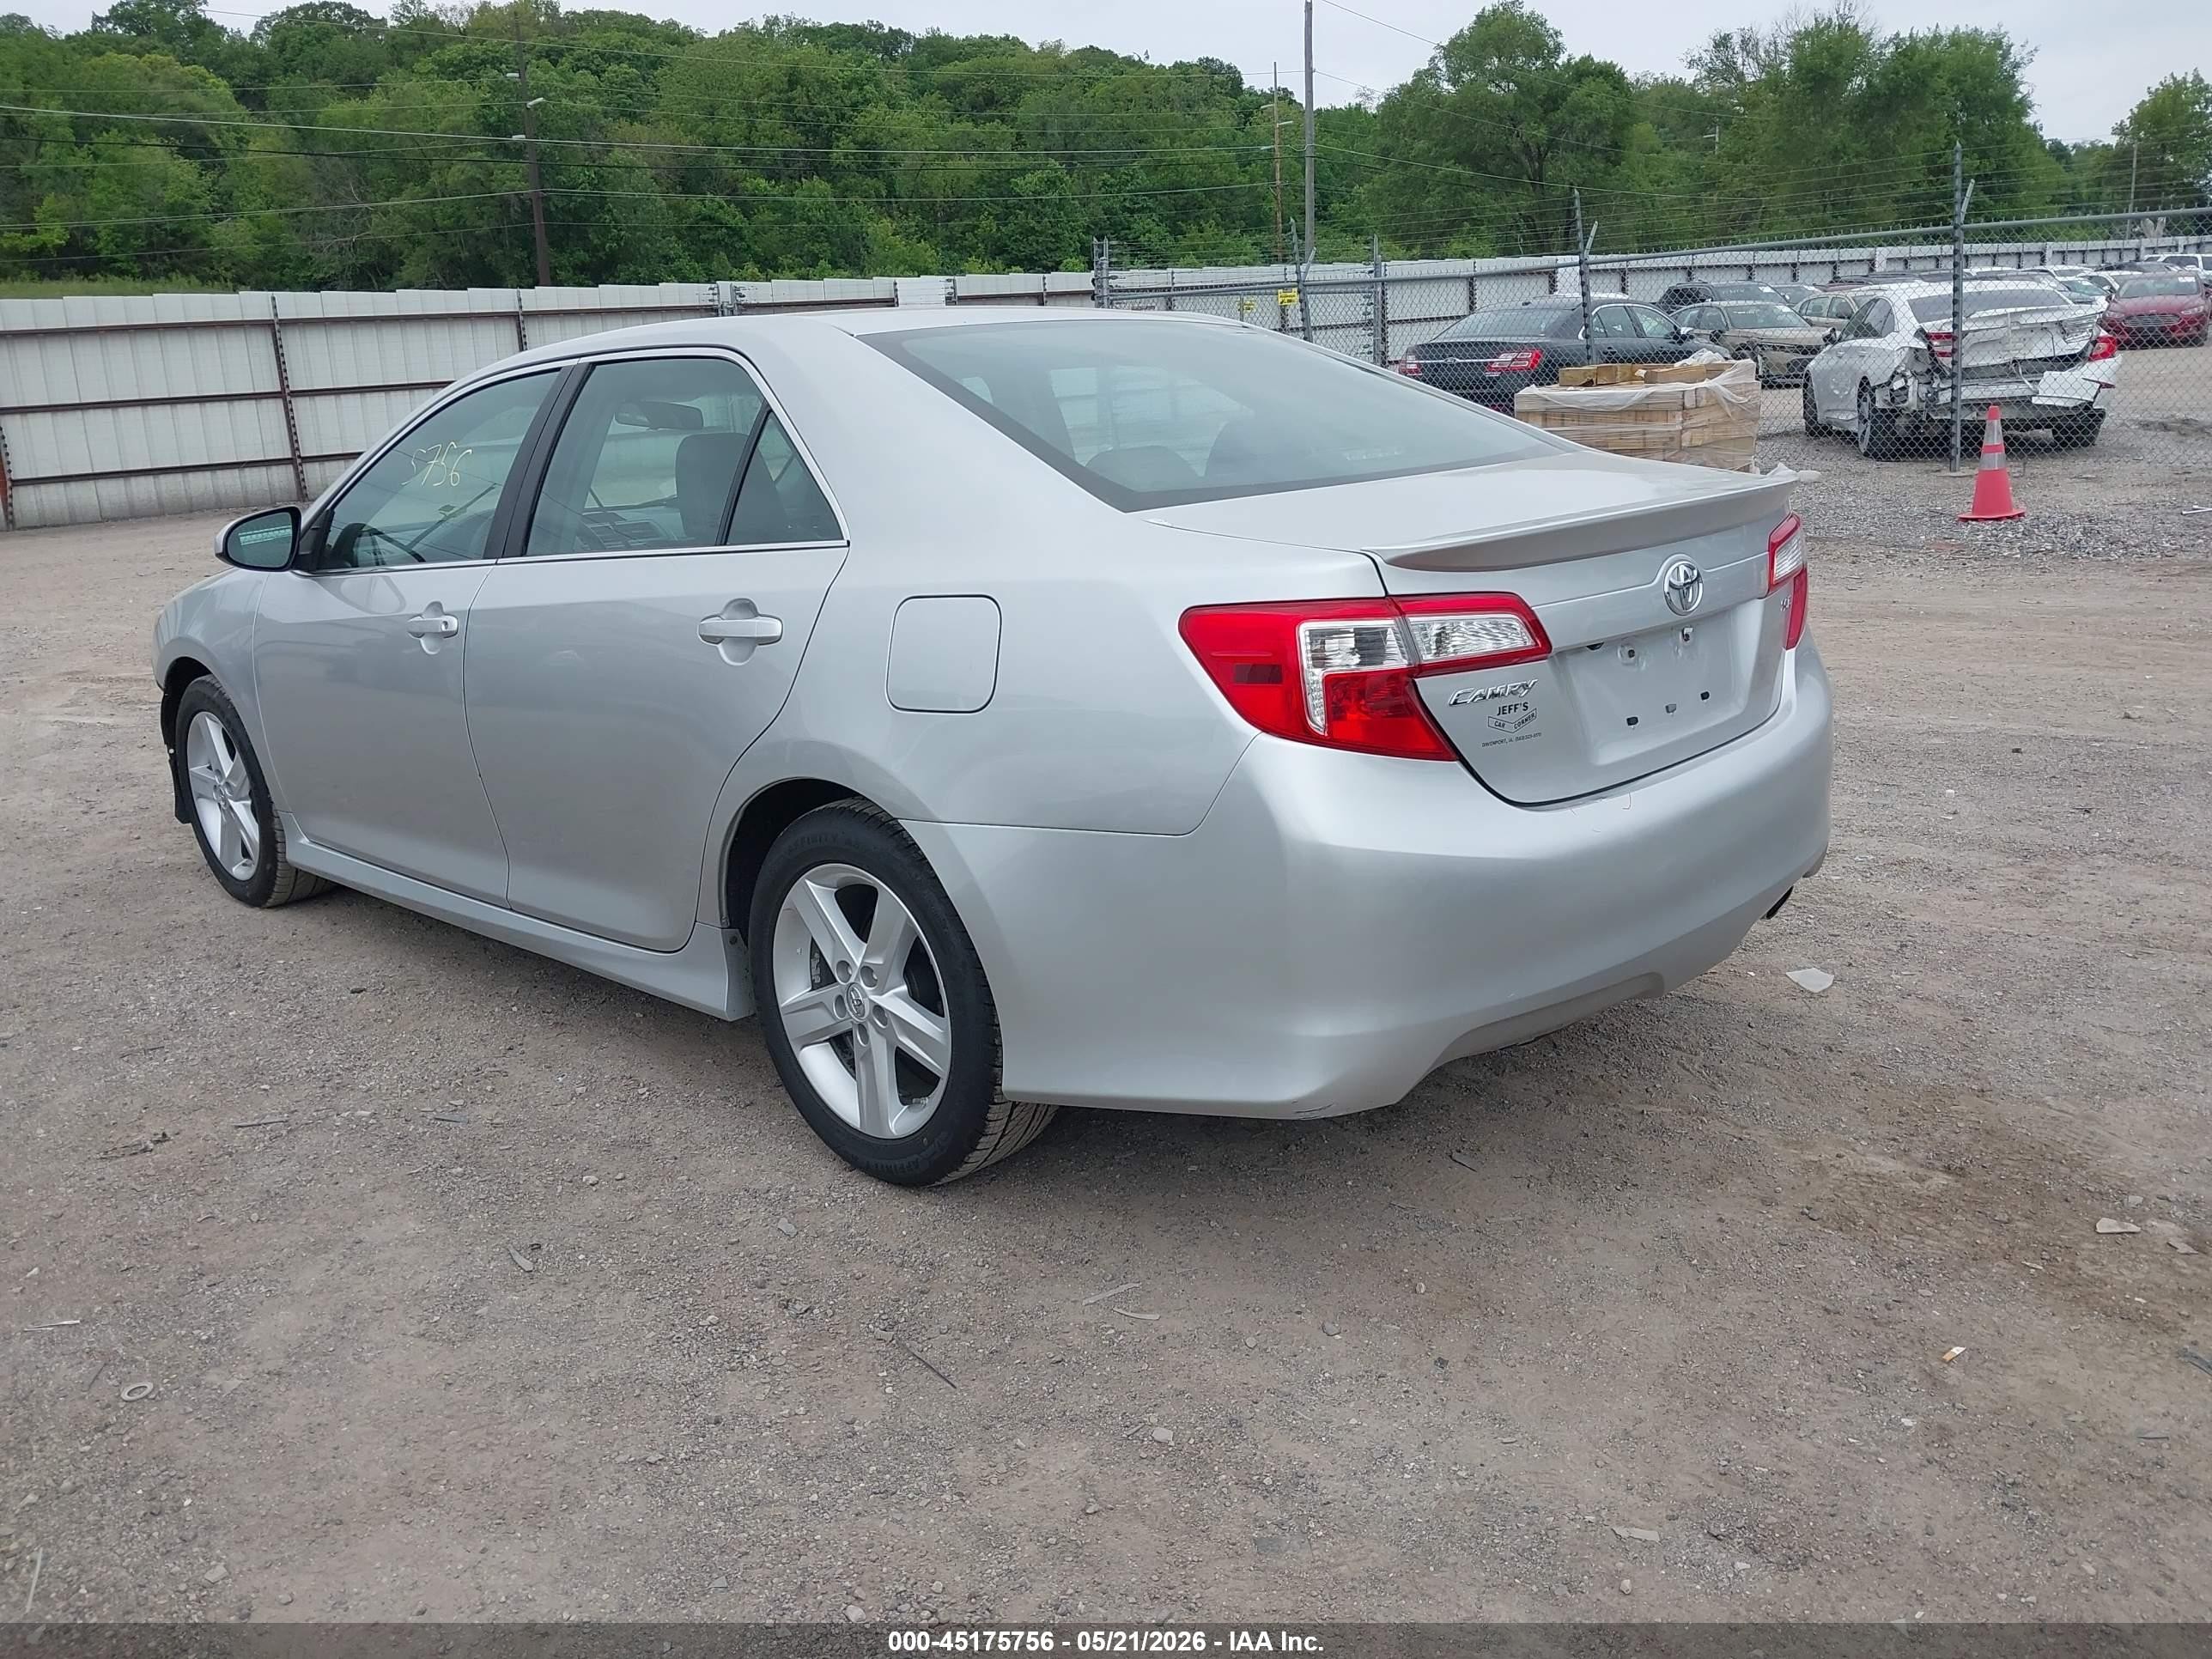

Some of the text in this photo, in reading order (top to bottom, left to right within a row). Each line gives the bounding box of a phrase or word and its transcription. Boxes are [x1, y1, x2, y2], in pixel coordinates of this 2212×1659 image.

[401, 441, 473, 487] 5756
[1449, 678, 1538, 706] CAMRY
[1497, 702, 1528, 716] JEFF'S
[1514, 713, 1535, 729] CORNER
